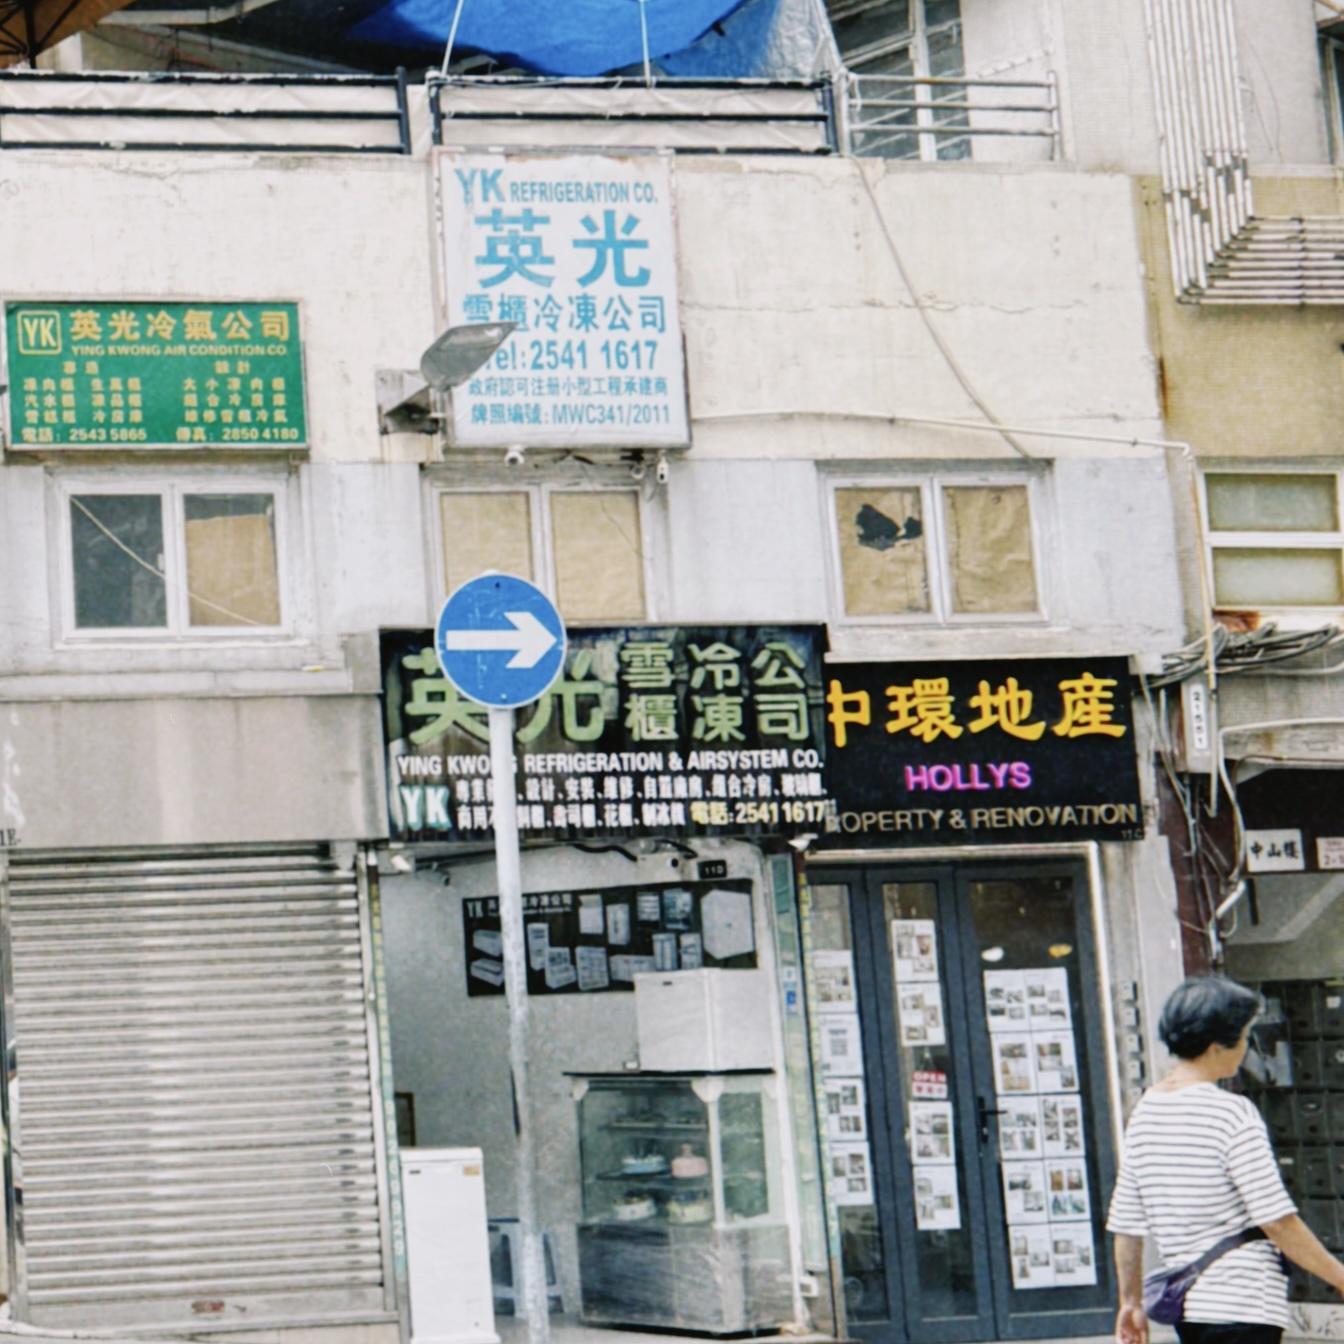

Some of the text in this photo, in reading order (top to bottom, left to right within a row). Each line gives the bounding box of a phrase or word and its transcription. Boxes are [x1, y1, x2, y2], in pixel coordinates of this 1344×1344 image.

[454, 168, 658, 204] YK REFRIGERATION CO.
[474, 208, 651, 288] 英光
[70, 310, 289, 341] 英光冷氣公司
[463, 294, 666, 333] 雪櫃冷凍公司
[23, 318, 55, 347] YK
[72, 345, 105, 356] YING
[108, 345, 160, 356] KWONG
[164, 345, 186, 356] AIR
[189, 345, 264, 356] CONDITION
[485, 340, 658, 371] el:2541 1617
[69, 428, 106, 441] 2543
[398, 748, 824, 775] YING KWO REFRIGERATION & AIRSYSTEM CO.
[906, 762, 1032, 791] HOLLYS
[400, 786, 452, 831] YK
[782, 800, 825, 823] 1617
[949, 808, 966, 829] &
[972, 803, 1137, 828] RENOVATION
